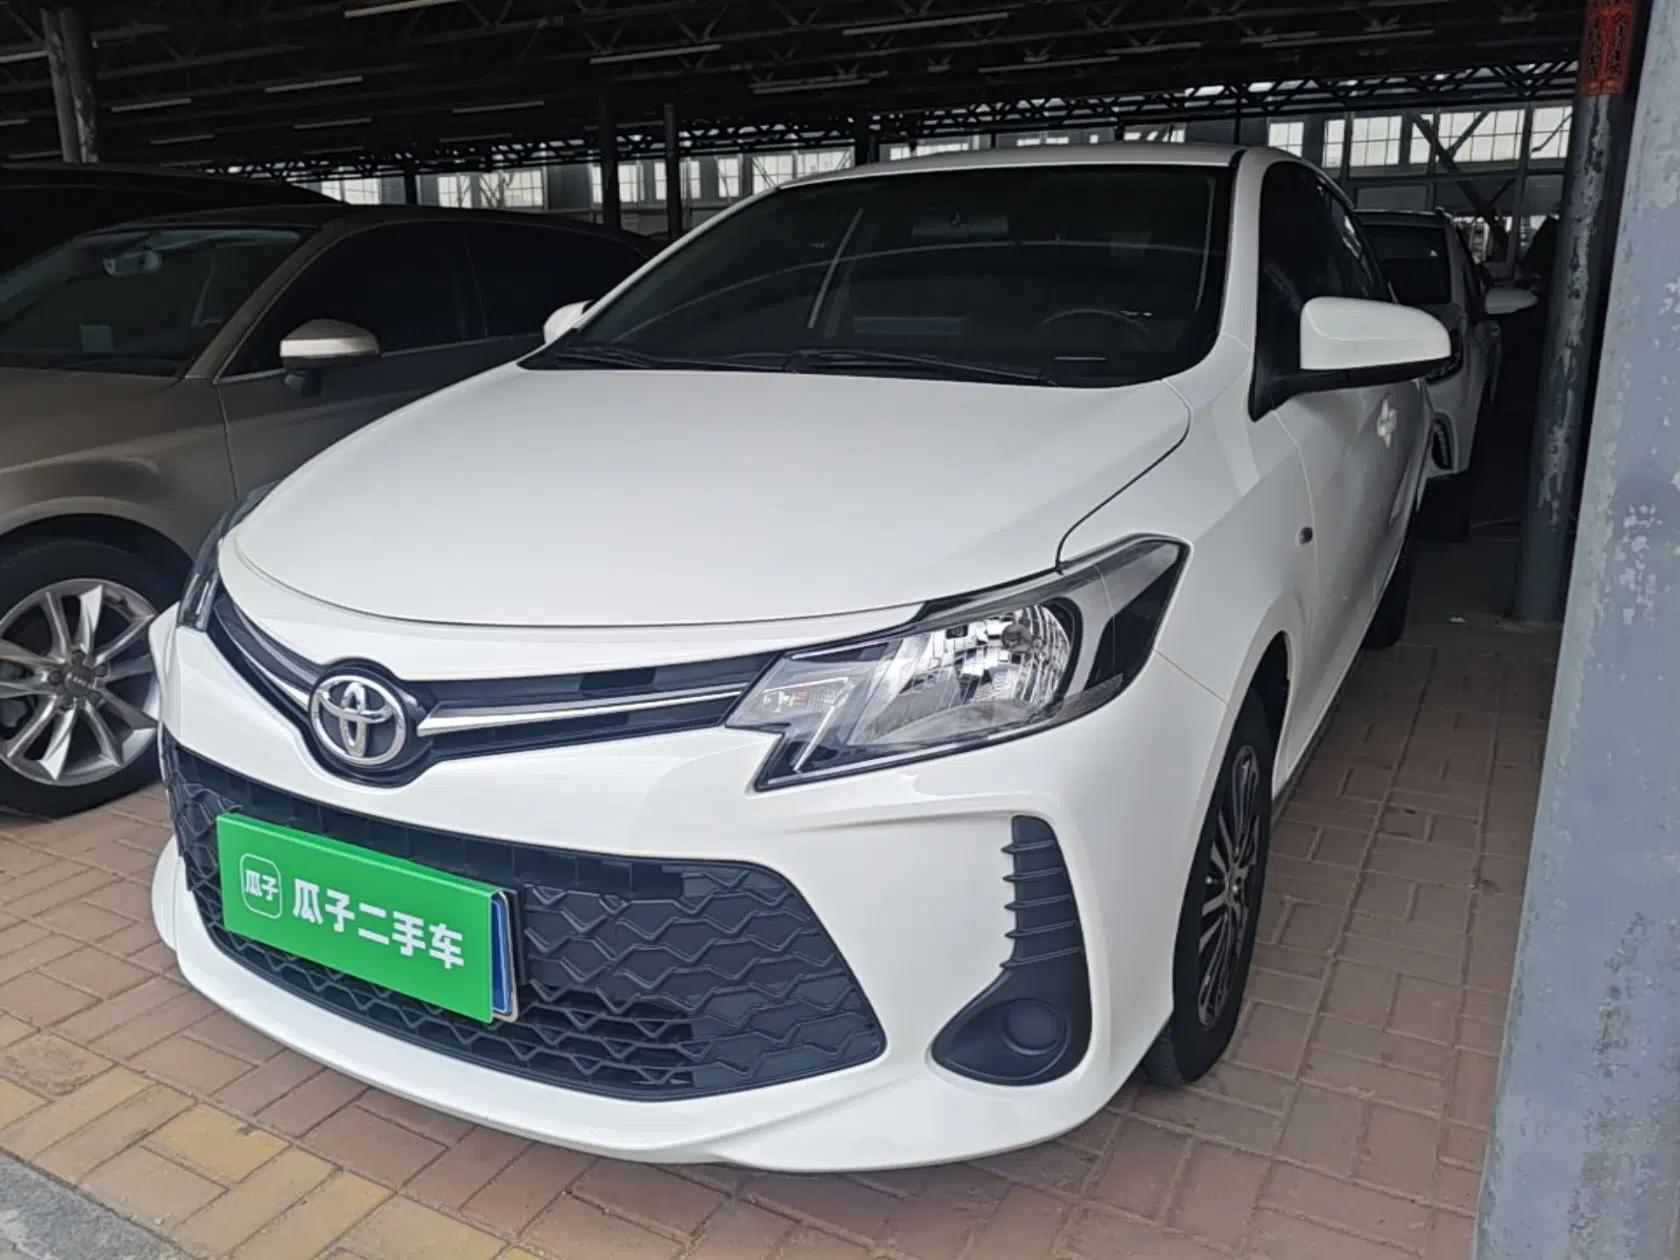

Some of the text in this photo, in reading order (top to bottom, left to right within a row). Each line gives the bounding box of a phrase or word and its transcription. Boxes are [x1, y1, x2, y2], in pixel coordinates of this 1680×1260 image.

[245, 869, 278, 901] 瓜子
[293, 878, 465, 970] 瓜子二手车
